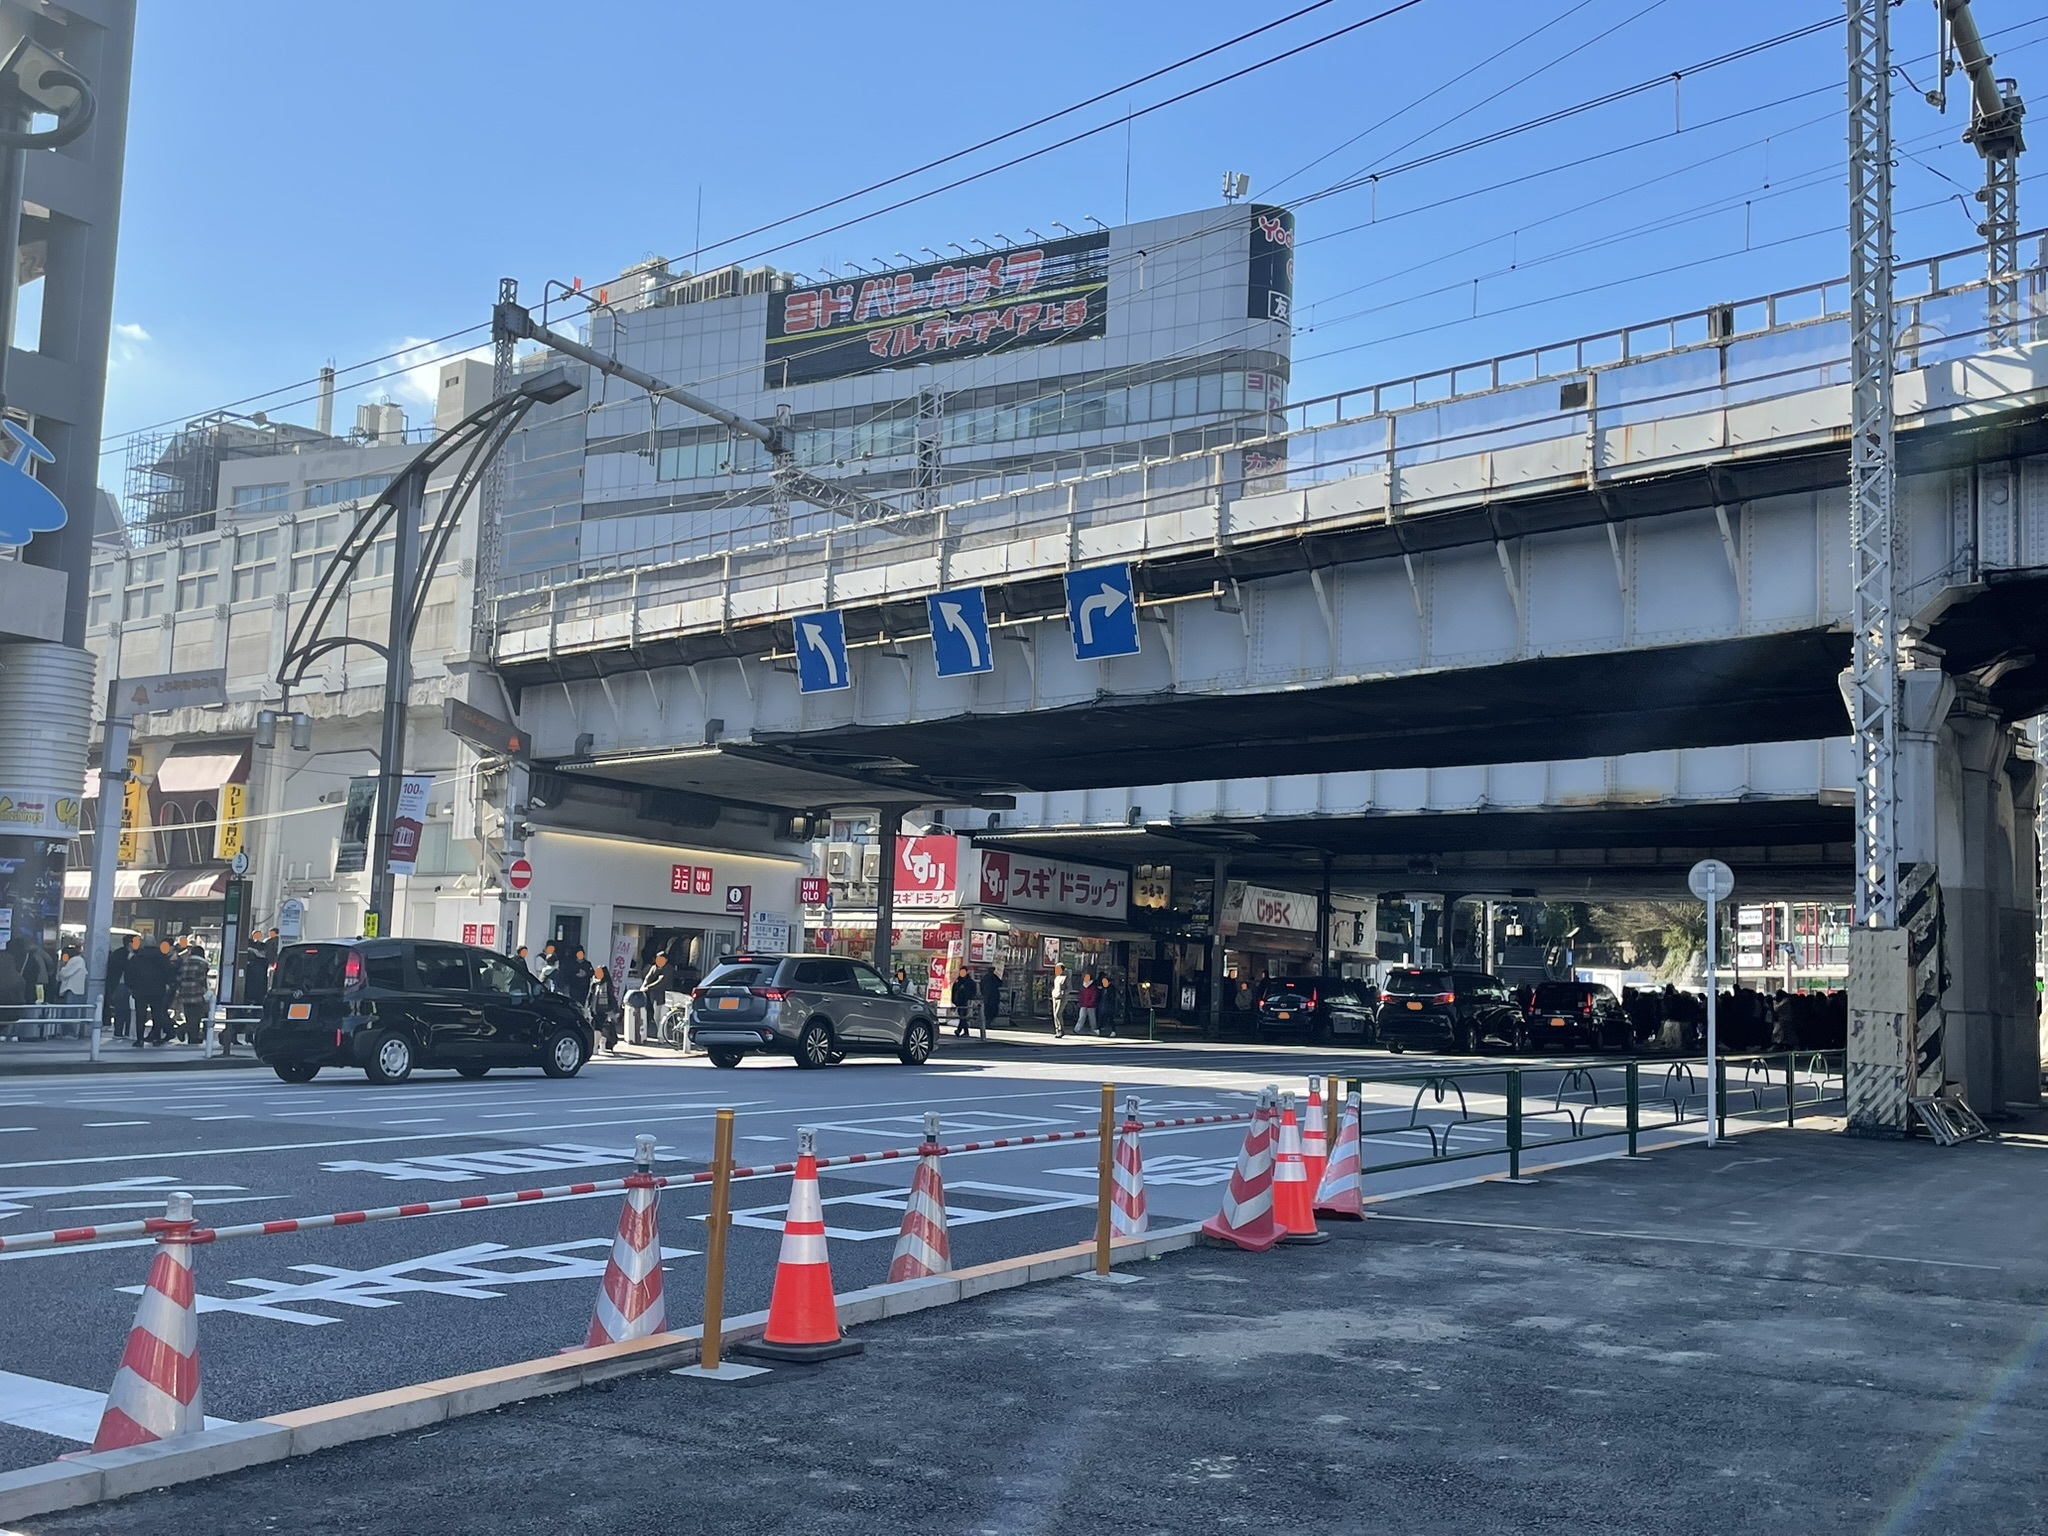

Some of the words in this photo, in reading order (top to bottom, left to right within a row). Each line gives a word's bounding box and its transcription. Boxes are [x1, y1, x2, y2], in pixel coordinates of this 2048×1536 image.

[784, 248, 1044, 334] ヨドバシカメラ
[867, 299, 1089, 358] マルチメディア上野
[403, 783, 420, 795] 100
[902, 837, 946, 890] くすり
[981, 853, 1008, 903] くすり
[802, 880, 819, 890] UNI
[802, 890, 819, 901] QLO
[893, 892, 952, 904] スギドラッグ
[1012, 866, 1124, 908] スギドラッグ
[1256, 897, 1291, 926] じゅらく
[924, 931, 934, 940] 2F
